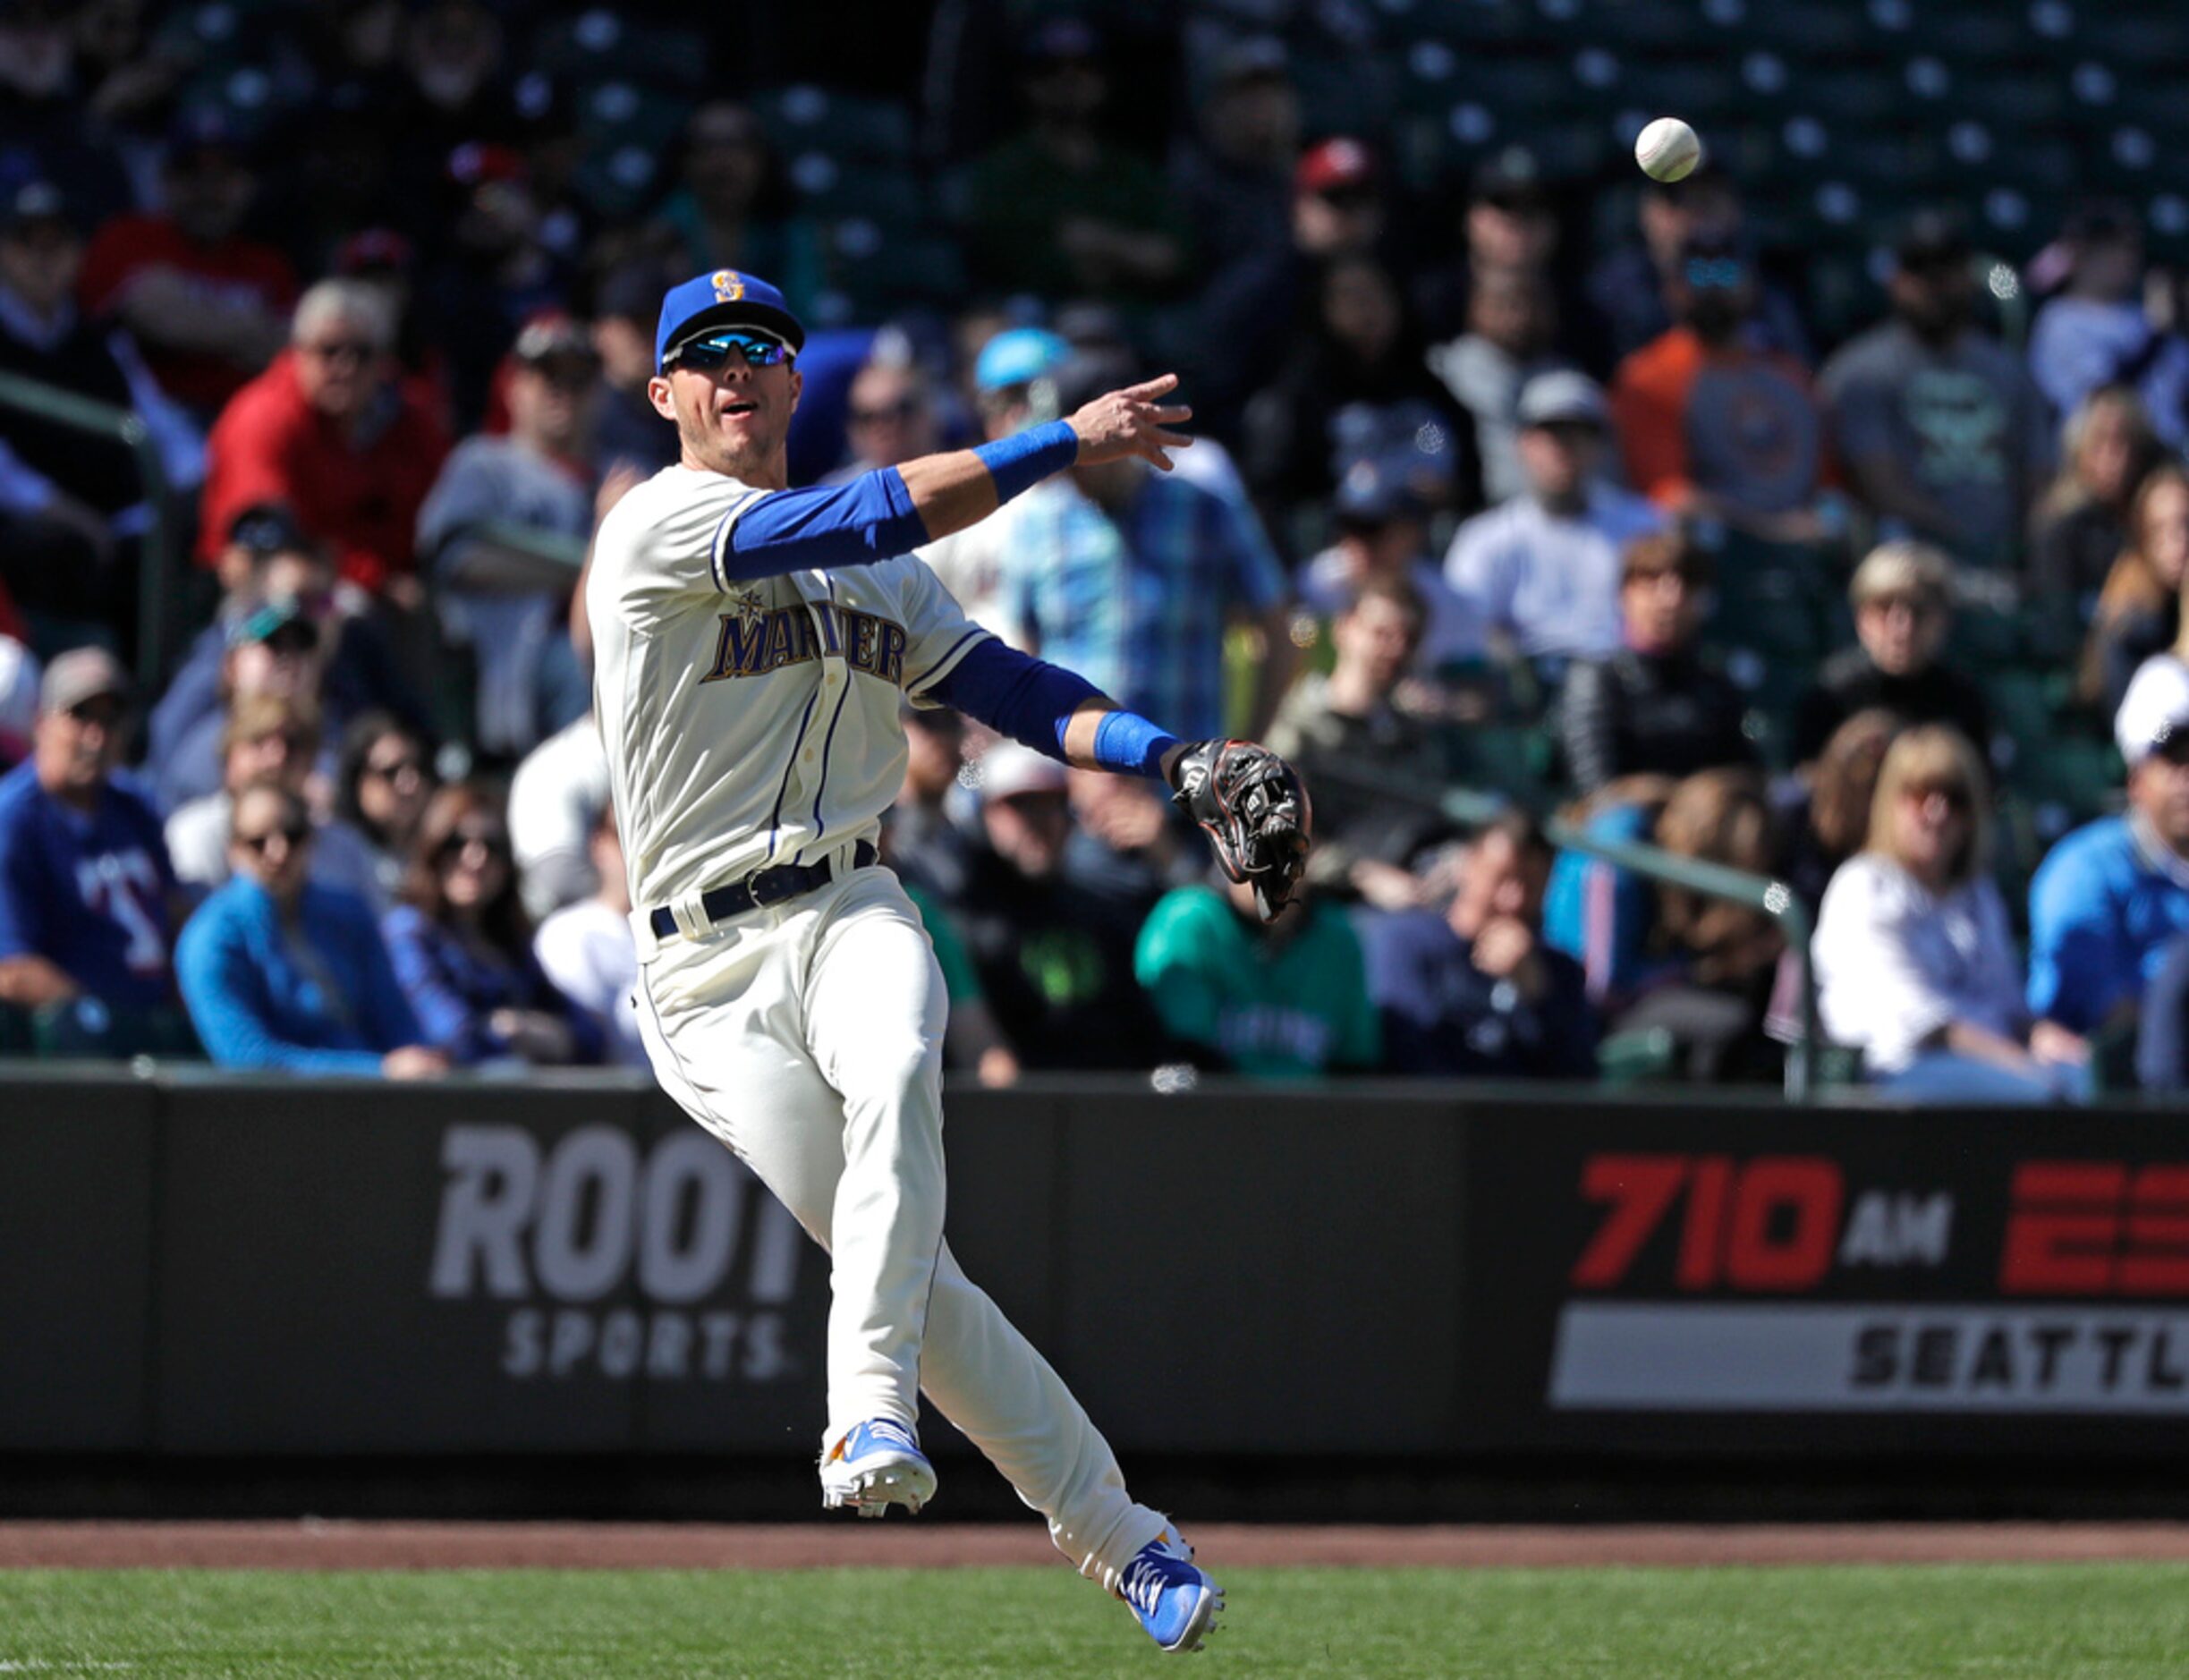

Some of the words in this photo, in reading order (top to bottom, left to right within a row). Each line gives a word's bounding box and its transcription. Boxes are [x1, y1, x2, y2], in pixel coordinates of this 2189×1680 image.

[711, 270, 744, 303] S
[1573, 1157, 1843, 1287] 710
[1839, 1190, 1951, 1266] AM
[503, 1311, 784, 1378] SPORTS
[1850, 1325, 2189, 1392] SEATTL
